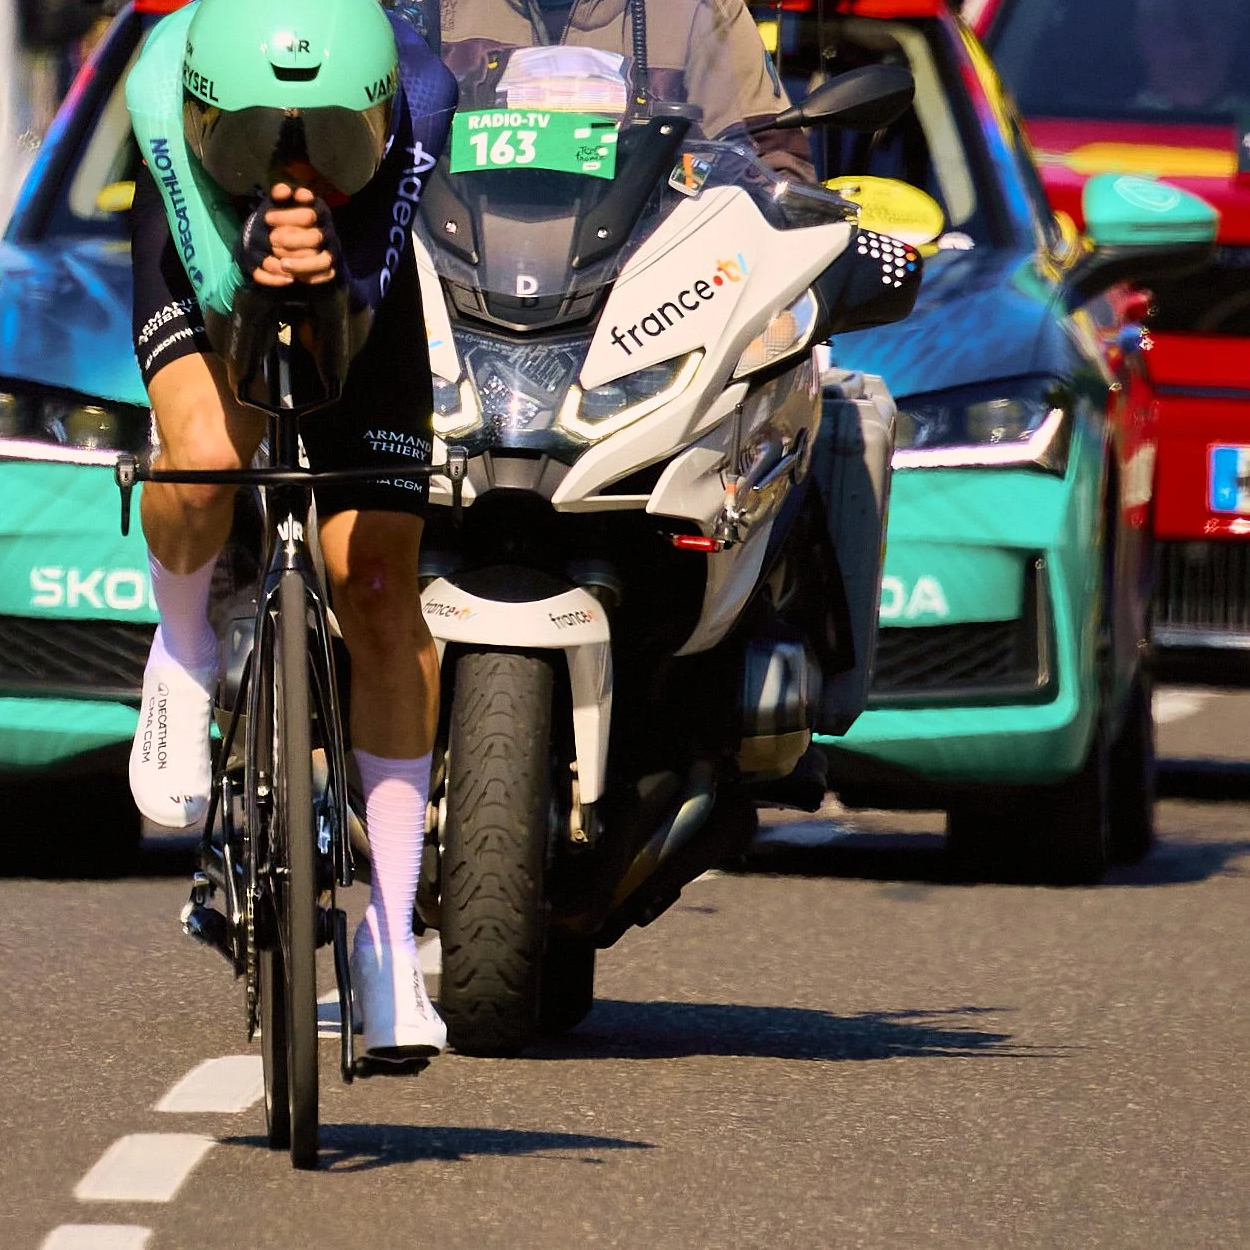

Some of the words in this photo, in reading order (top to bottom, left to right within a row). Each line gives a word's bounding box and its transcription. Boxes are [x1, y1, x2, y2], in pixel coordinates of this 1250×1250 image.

[468, 113, 550, 130] RADIO-TV
[469, 130, 538, 167] 163
[150, 138, 196, 263] DECATHLON
[363, 430, 431, 453] ARMAND
[370, 441, 428, 461] THIERY
[393, 478, 423, 494] CGM
[29, 565, 159, 611] SKO
[141, 730, 153, 764] CGM
[157, 698, 168, 770] DECATHLON
